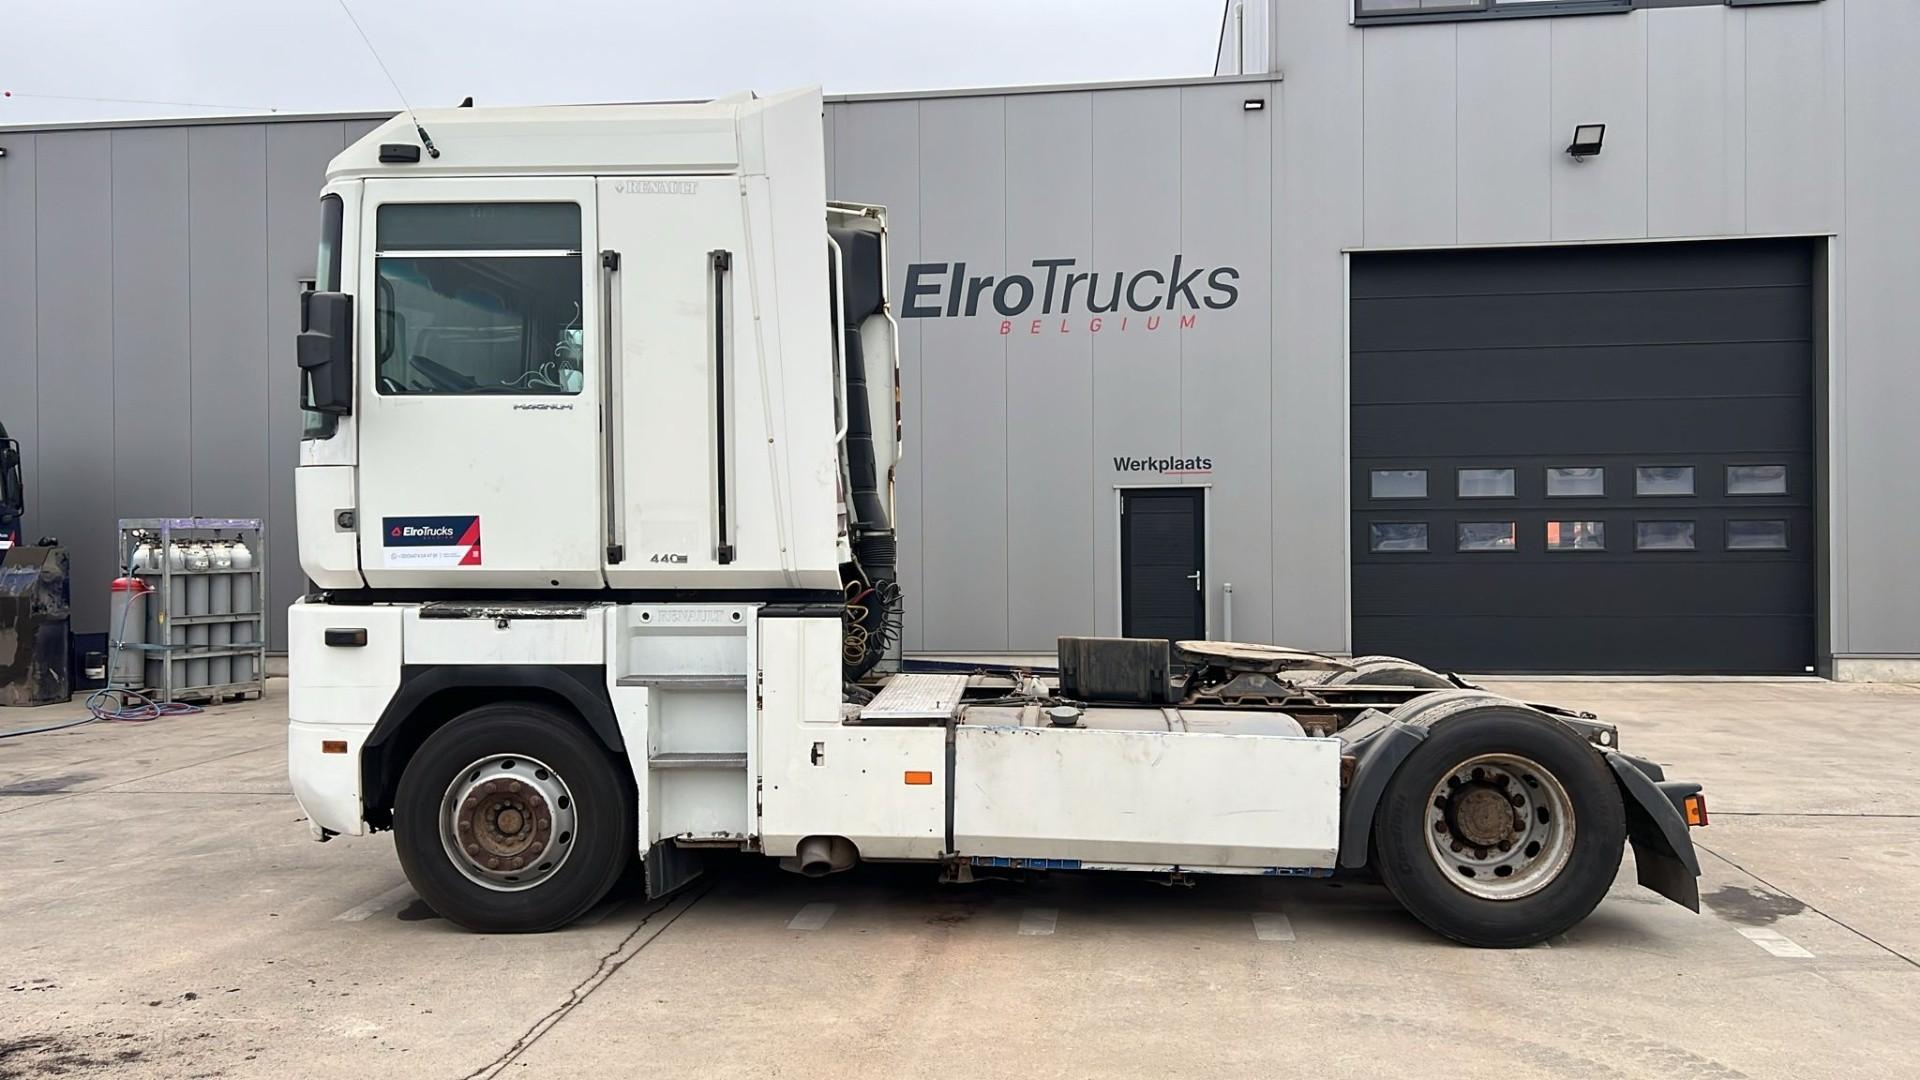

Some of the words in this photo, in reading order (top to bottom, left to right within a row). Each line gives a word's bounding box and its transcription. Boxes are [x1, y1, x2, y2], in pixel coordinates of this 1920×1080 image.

[627, 180, 697, 194] RENAULT
[901, 254, 1240, 319] ElroTrucks
[1000, 315, 1197, 335] BELGIUM
[1113, 456, 1212, 474] Werkplaats
[403, 526, 454, 536] ElroTrucks
